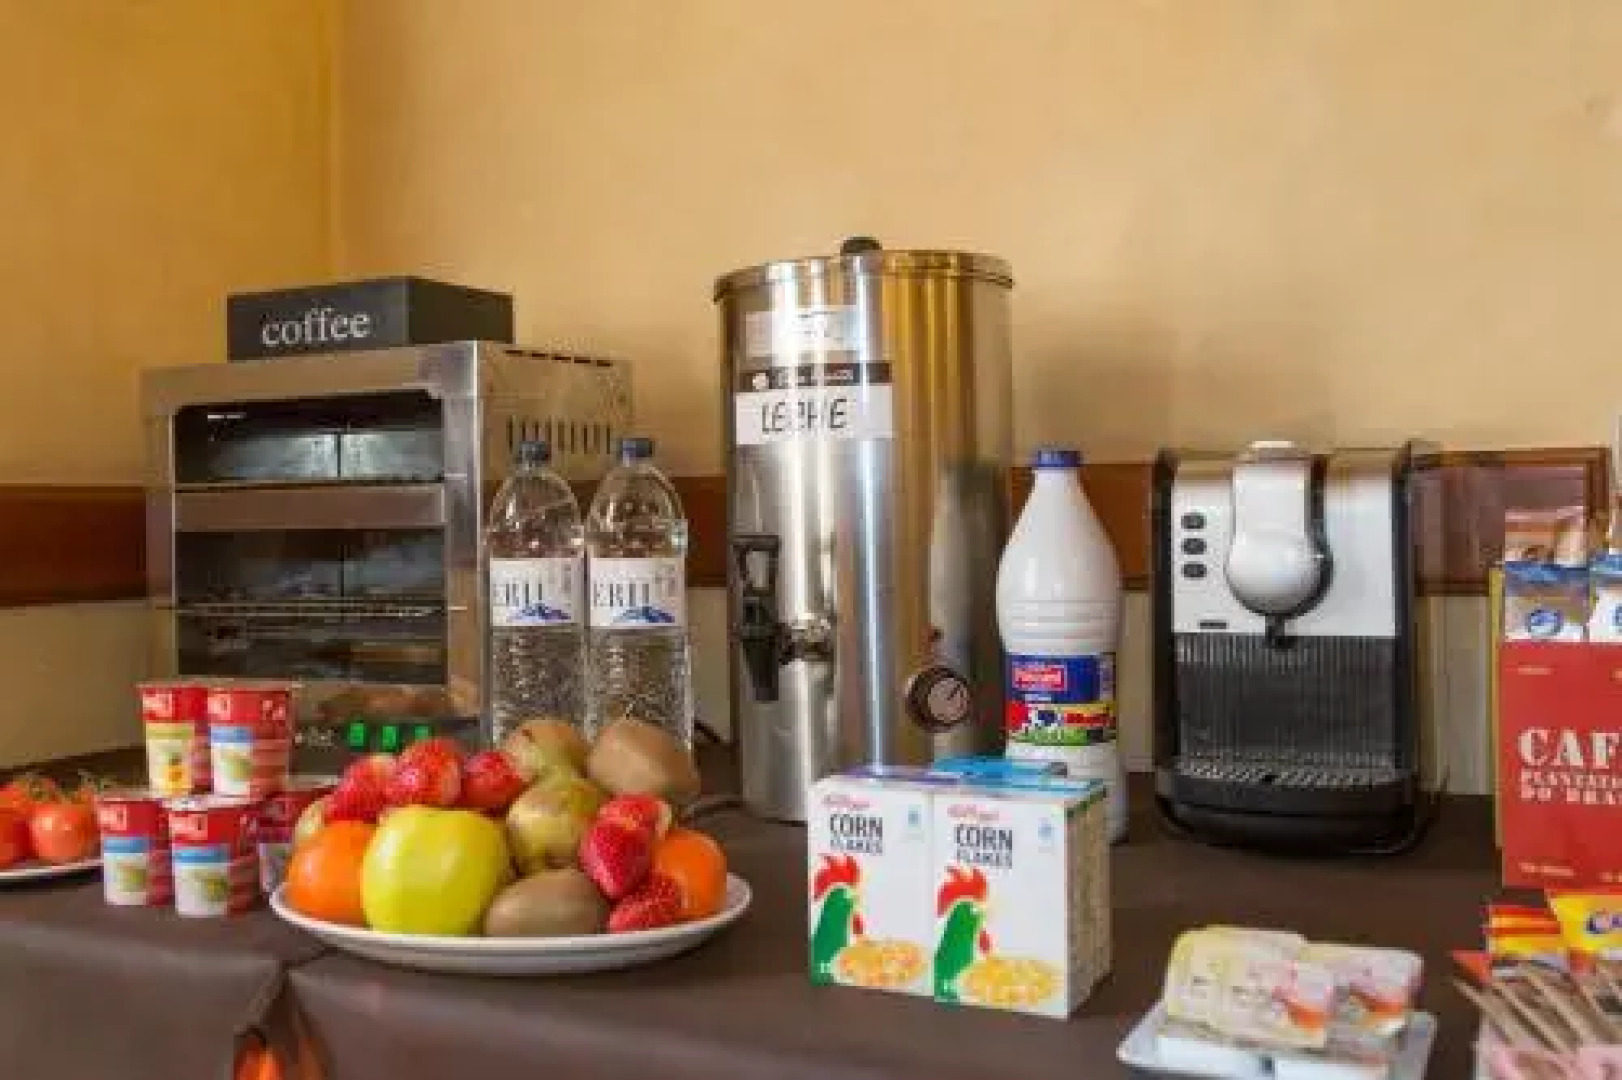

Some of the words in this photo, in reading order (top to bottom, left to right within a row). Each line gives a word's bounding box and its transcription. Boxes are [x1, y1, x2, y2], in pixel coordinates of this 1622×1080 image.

[262, 306, 370, 347] coffee
[830, 813, 885, 839] CORN
[955, 823, 1013, 851] CORN
